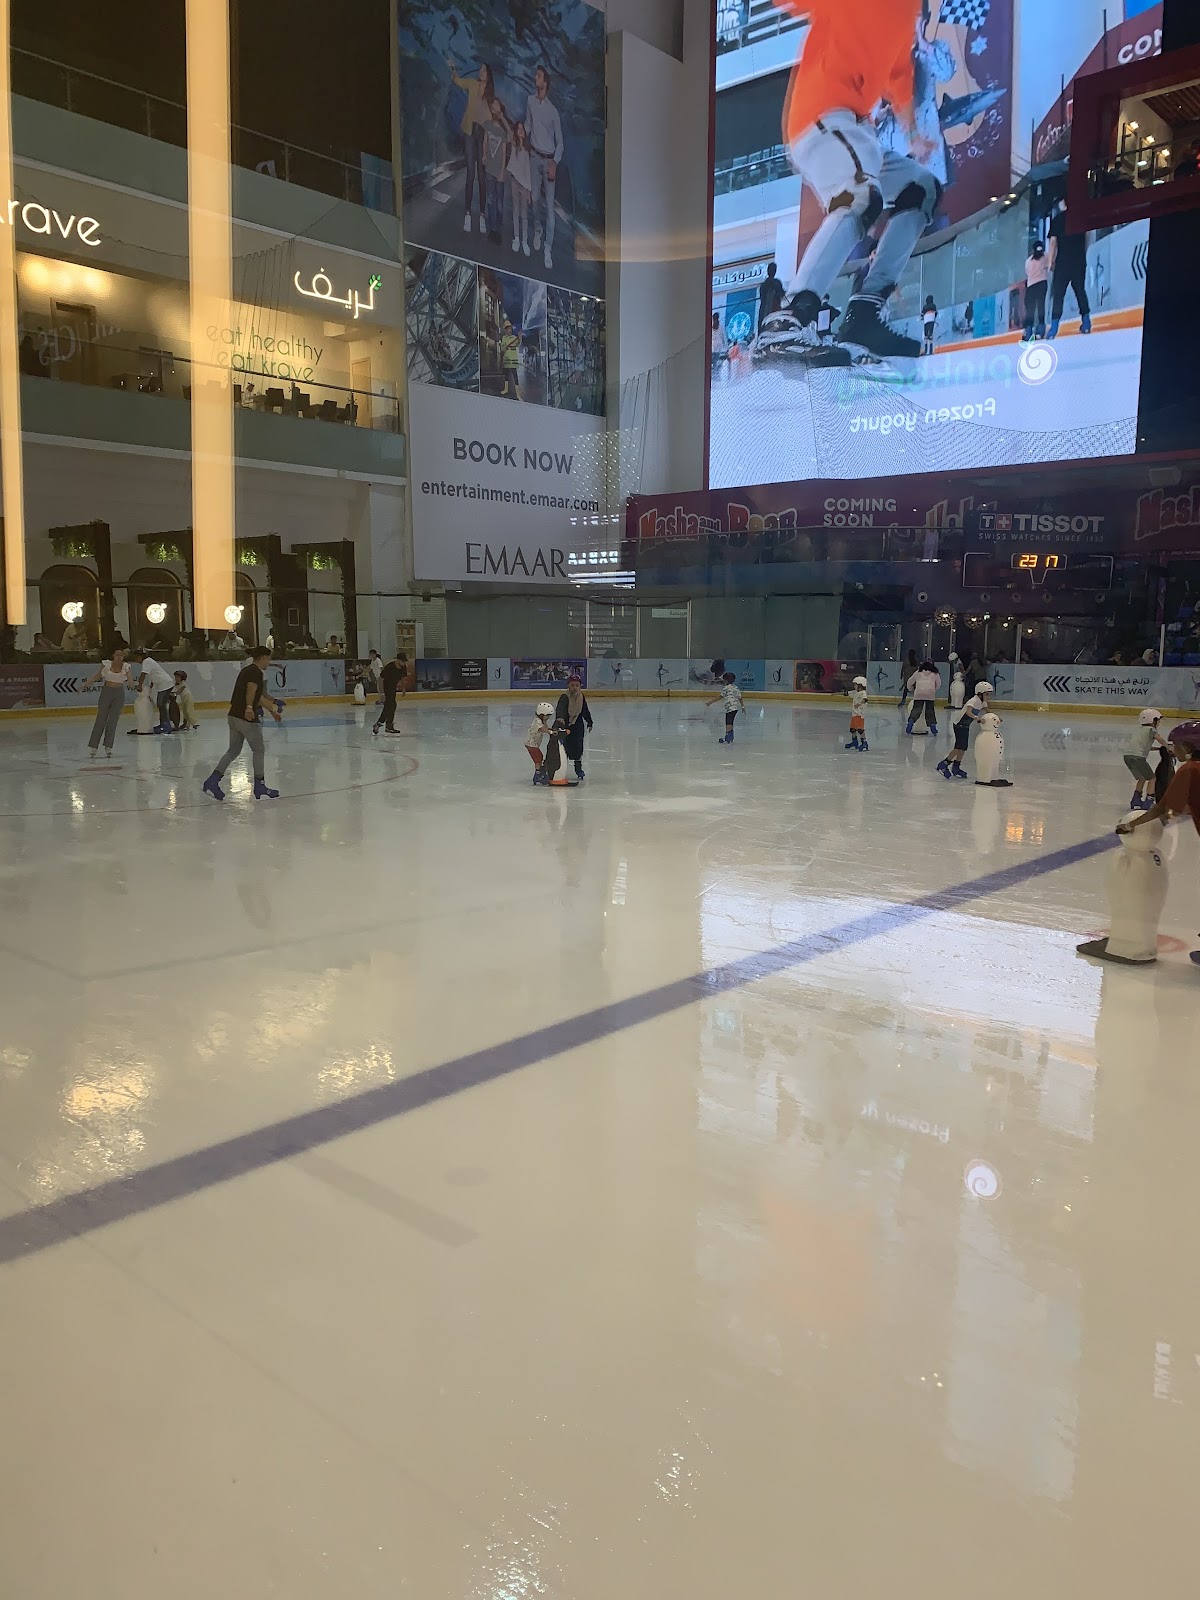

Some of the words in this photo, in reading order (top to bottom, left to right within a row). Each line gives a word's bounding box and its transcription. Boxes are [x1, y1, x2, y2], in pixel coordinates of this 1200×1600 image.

[0, 199, 102, 247] rave
[206, 325, 243, 347] eat
[250, 326, 323, 366] healthy
[217, 351, 253, 372] eat
[261, 354, 315, 383] krave
[452, 437, 518, 468] BOOK
[523, 448, 574, 475] NOW
[421, 479, 600, 512] entertainment.emaar.com
[823, 498, 897, 512] COMING
[638, 505, 699, 554] Masha
[823, 513, 874, 527] SOON
[1014, 514, 1105, 533] TISSOT
[978, 532, 1007, 541] SWISS
[1011, 533, 1051, 542] WATCHES
[1055, 534, 1081, 543] SINCE
[465, 542, 568, 578] EMAAR
[1019, 554, 1038, 568] 23
[1045, 555, 1060, 568] 17
[1075, 686, 1103, 694] SKATE
[1106, 687, 1125, 695] THIS
[1128, 687, 1150, 695] WAY
